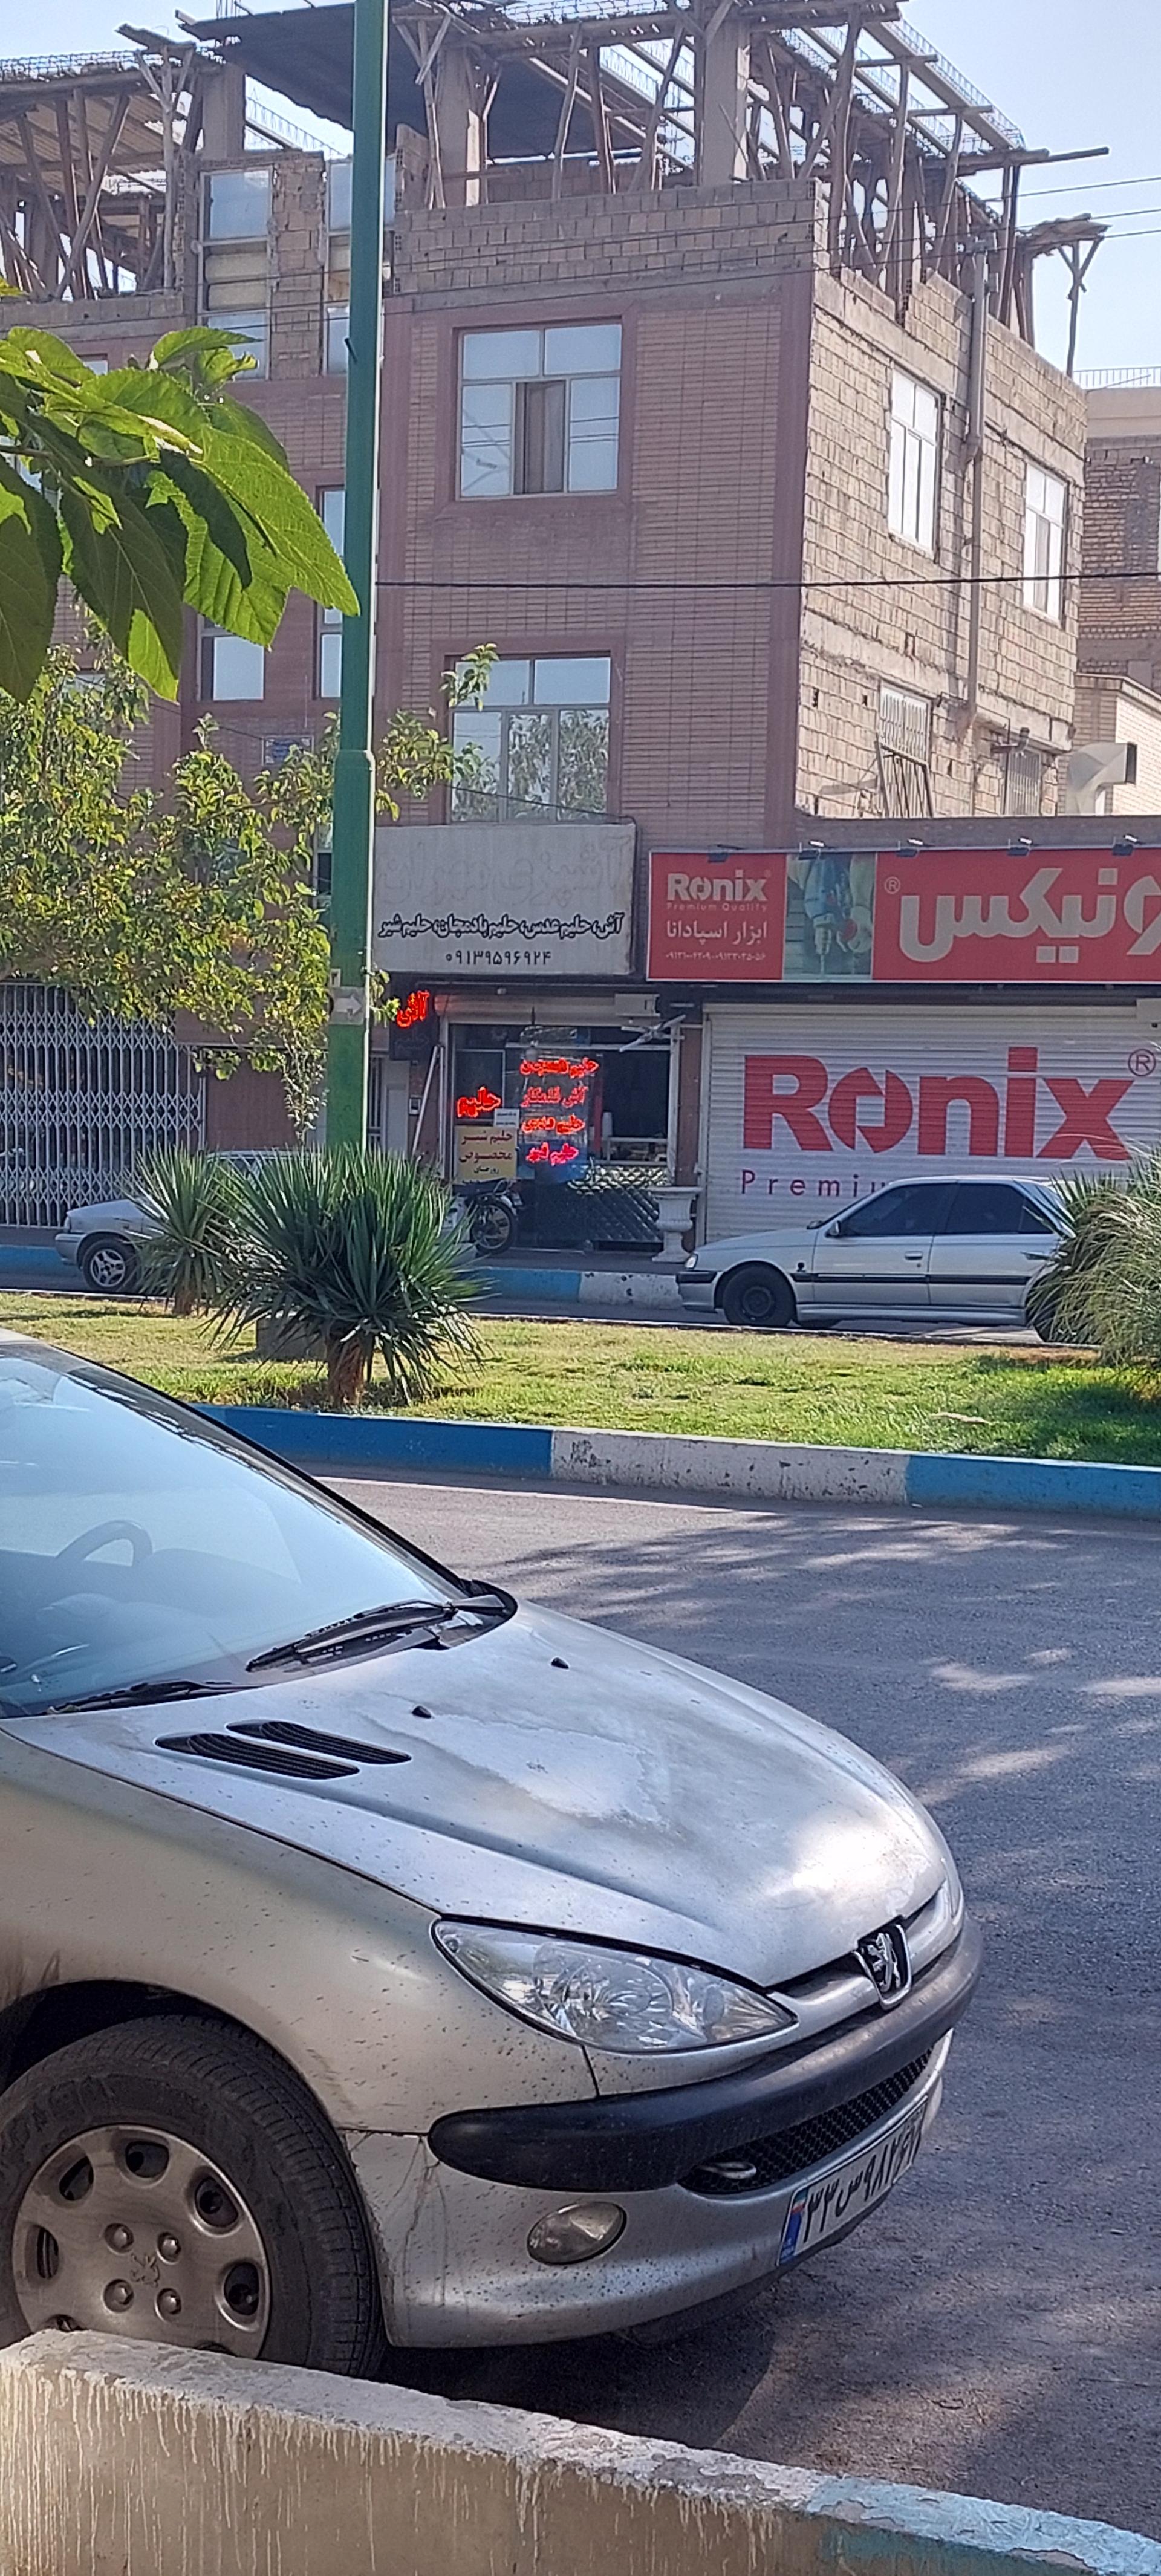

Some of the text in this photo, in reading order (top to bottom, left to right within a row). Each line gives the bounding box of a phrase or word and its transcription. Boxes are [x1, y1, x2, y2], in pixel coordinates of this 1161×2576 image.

[667, 869, 768, 901] Ronix
[666, 902, 767, 913] Premium Quality
[377, 913, 403, 938] شیر
[401, 913, 433, 938] حلیم
[488, 913, 521, 940] حلیم
[559, 913, 593, 940] حلیم
[666, 920, 767, 946] ابزار اسپادانا
[446, 949, 551, 966] ۰۹۱۳۹۵۹۶۹۲۴
[396, 989, 431, 1027] آش
[457, 1086, 502, 1118] حلیم
[743, 1046, 1135, 1161] Ronix
[489, 1130, 513, 1145] حلیم
